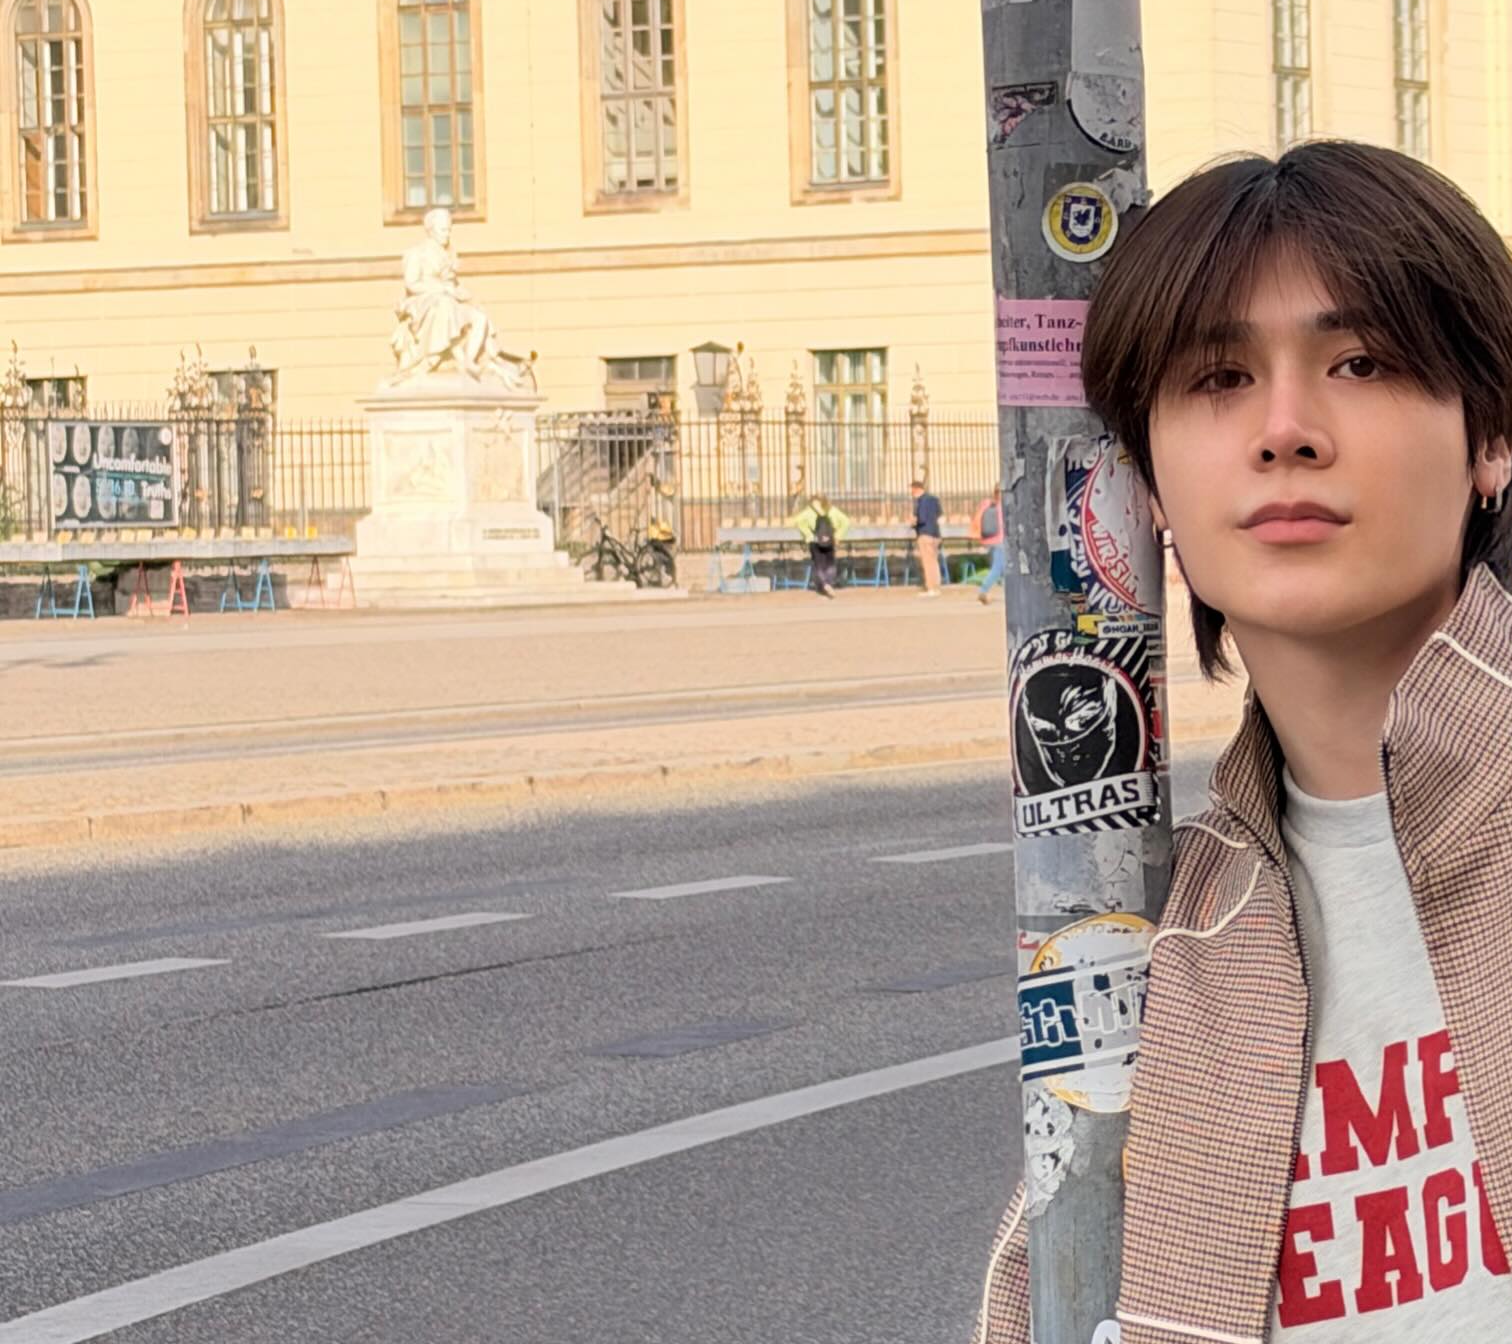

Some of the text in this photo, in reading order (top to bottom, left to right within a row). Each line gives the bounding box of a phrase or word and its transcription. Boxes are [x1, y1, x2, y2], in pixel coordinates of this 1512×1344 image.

[1034, 313, 1083, 330] Tanz-
[93, 451, 172, 476] Uncomfortable
[1022, 776, 1141, 828] ULTRAS
[1293, 1028, 1462, 1182] MP
